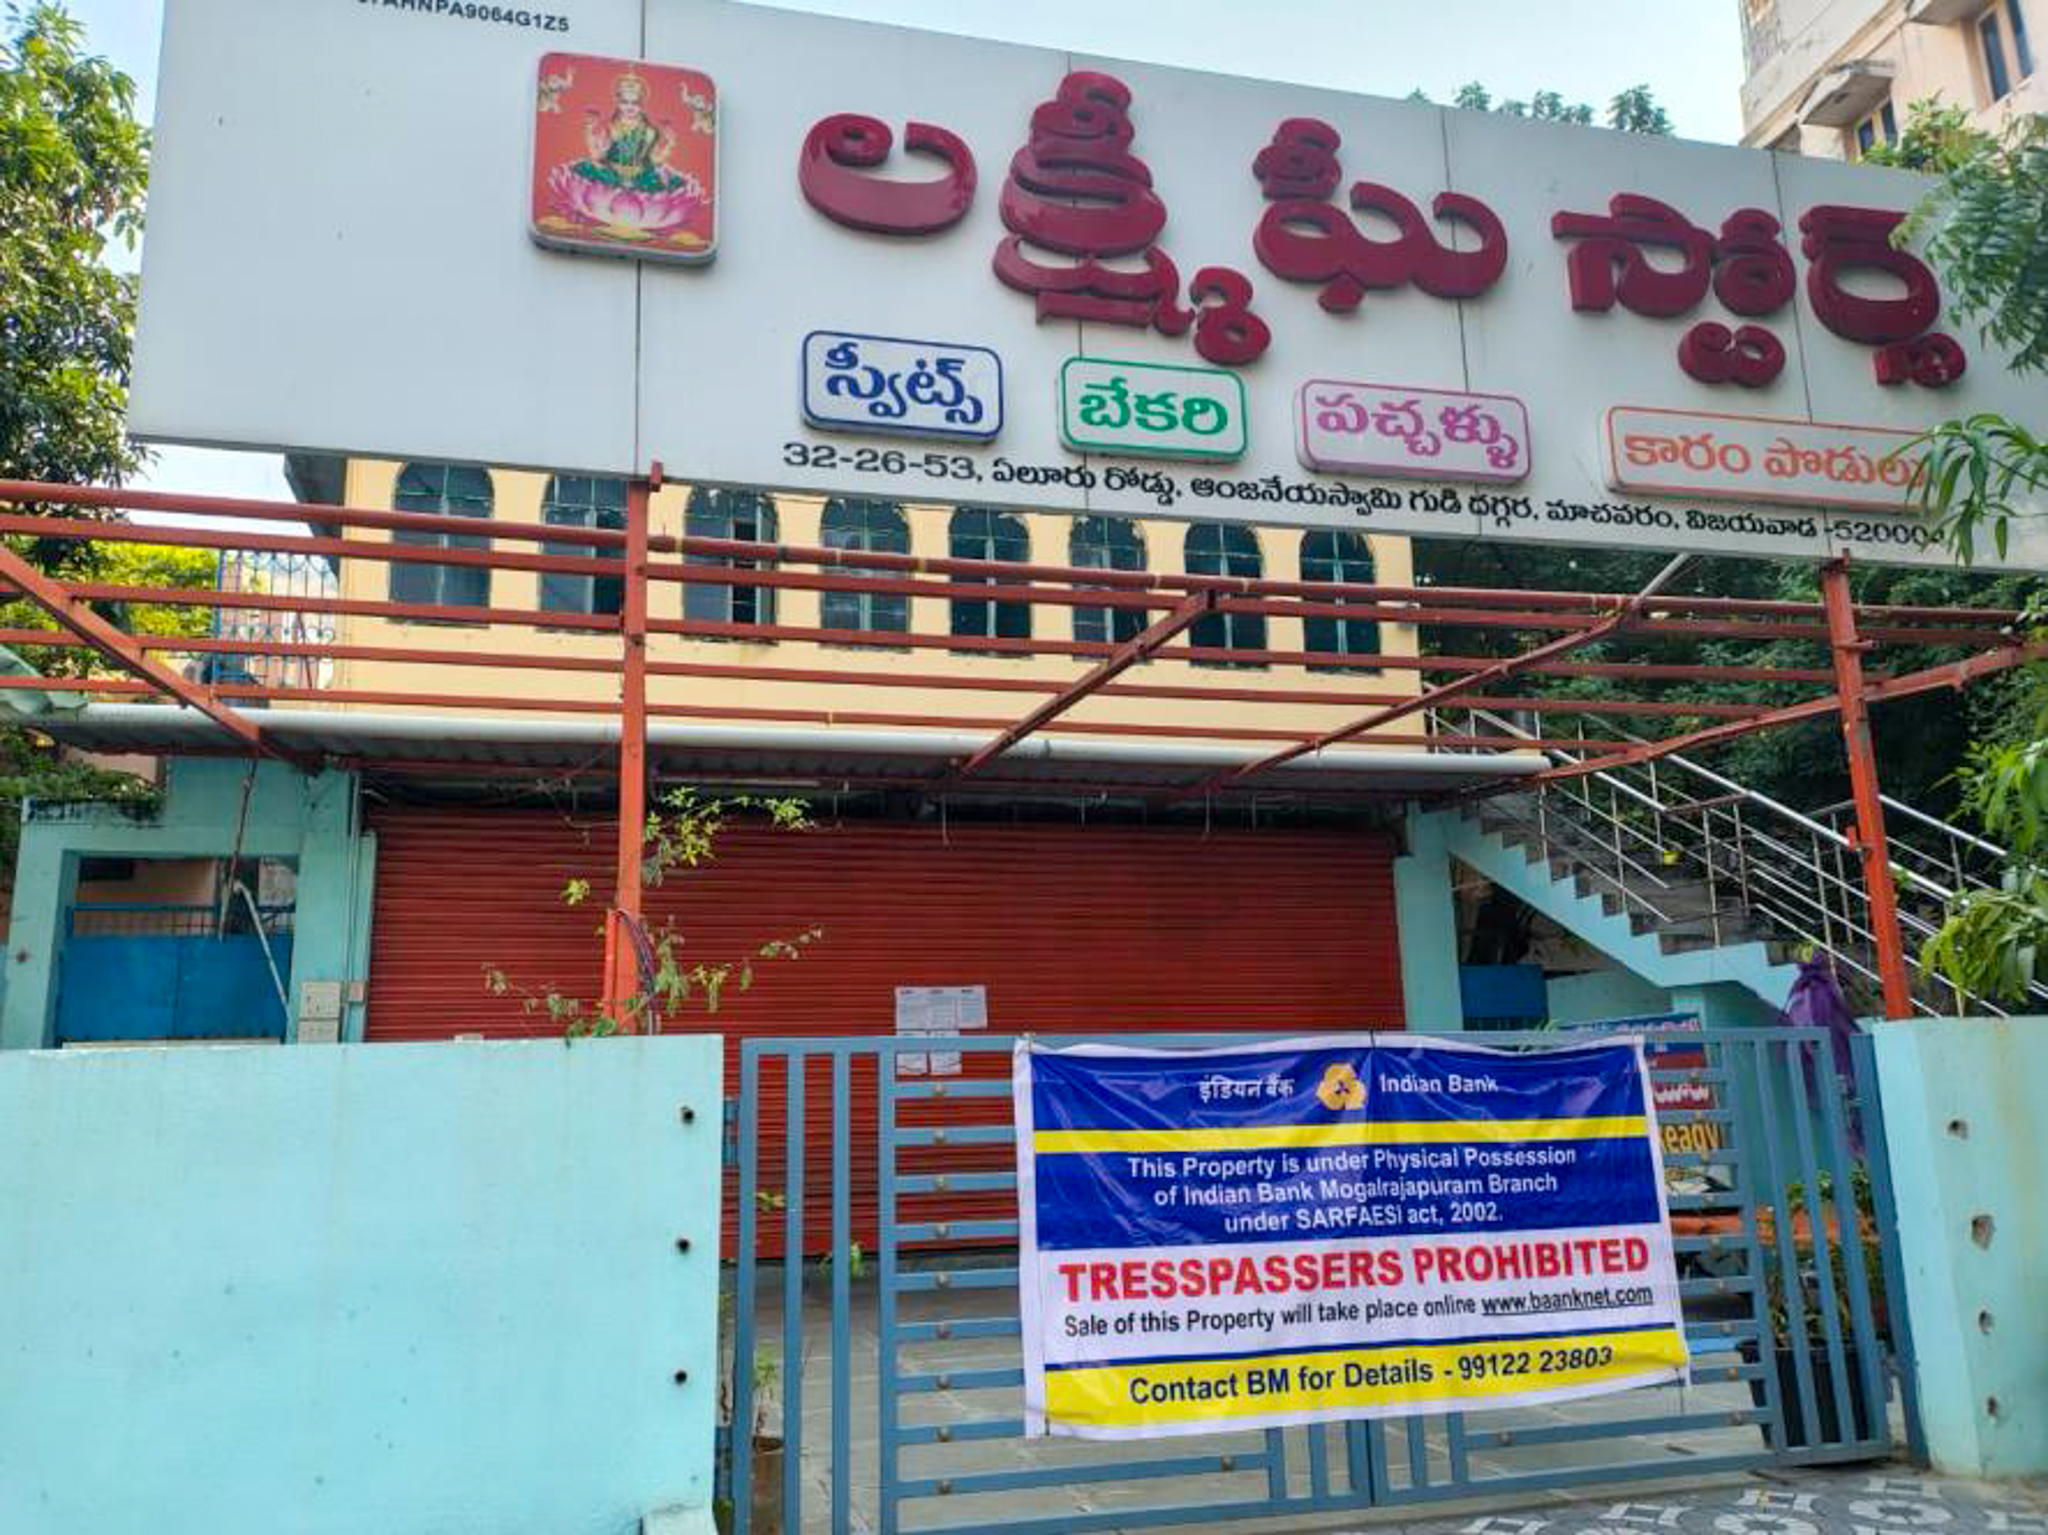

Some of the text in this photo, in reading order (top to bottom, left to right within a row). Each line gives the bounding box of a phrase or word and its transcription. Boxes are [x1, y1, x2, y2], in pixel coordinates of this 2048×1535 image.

[358, 0, 570, 31] AHNPA9064G1Z5
[826, 342, 983, 425] స్వీట్స్
[1079, 377, 1229, 435] బేకరి
[1625, 434, 1750, 473] కారం
[993, 457, 1096, 490] ఏలూరు
[1409, 488, 1462, 514] గుడి
[1200, 1074, 1260, 1103] इंडियन
[1380, 1073, 1499, 1093] Indian Bank
[1127, 1146, 1577, 1180] This Property is under Physical Possession
[1154, 1172, 1558, 1206] of Indian Bank Mogalrajapuram Branch
[1224, 1210, 1290, 1233] under
[1407, 1205, 1443, 1226] act,
[1451, 1201, 1503, 1223] 2002.
[1059, 1237, 1649, 1302] TRESSPASSERS PROHIBITED
[1065, 1286, 1655, 1337] Sale of this Property will take place online www.baanknet.com
[1130, 1375, 1239, 1404] Contact
[1247, 1368, 1290, 1395] BM
[1299, 1365, 1336, 1391] for
[1345, 1359, 1433, 1388] Details
[1458, 1352, 1530, 1380] 99122
[1539, 1346, 1613, 1372] 23803
